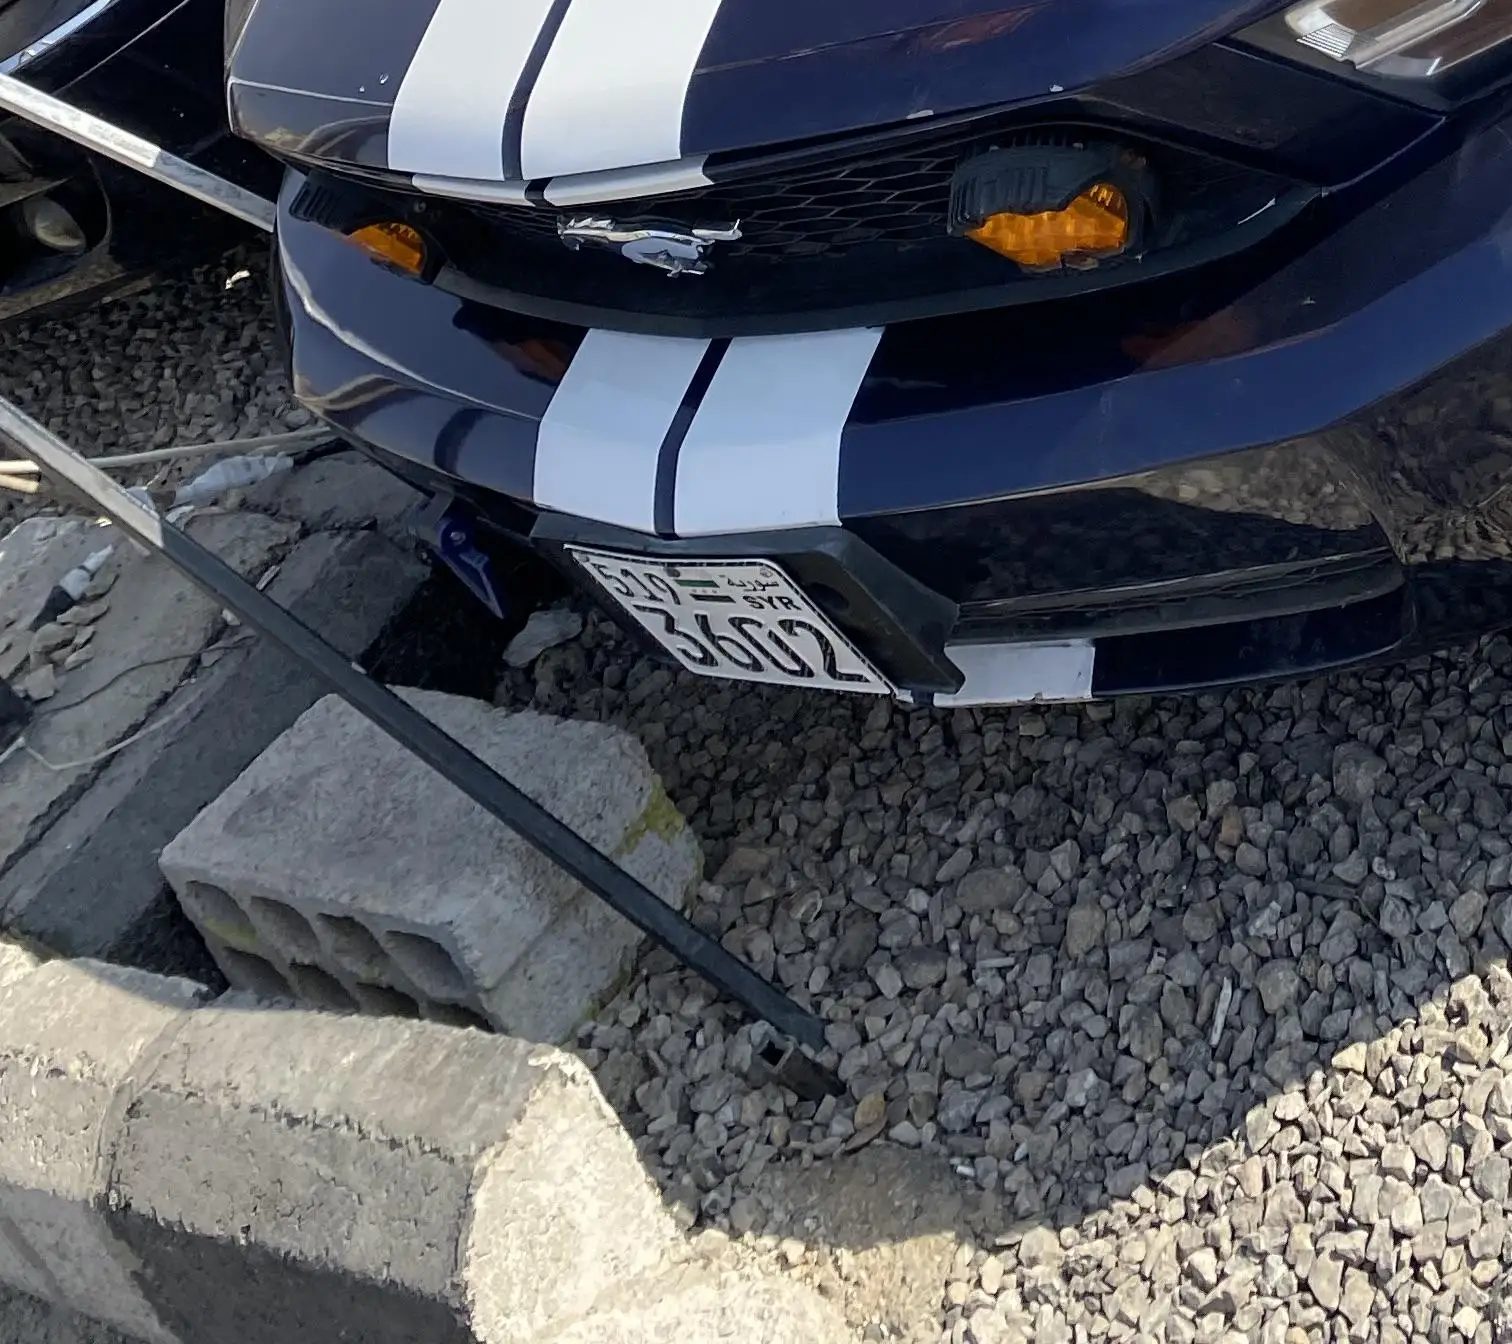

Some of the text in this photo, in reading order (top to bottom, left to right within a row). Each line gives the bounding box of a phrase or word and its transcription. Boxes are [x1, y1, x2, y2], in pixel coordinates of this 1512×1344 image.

[591, 562, 682, 606] 519
[743, 595, 803, 611] SYR
[632, 604, 872, 684] 3602
